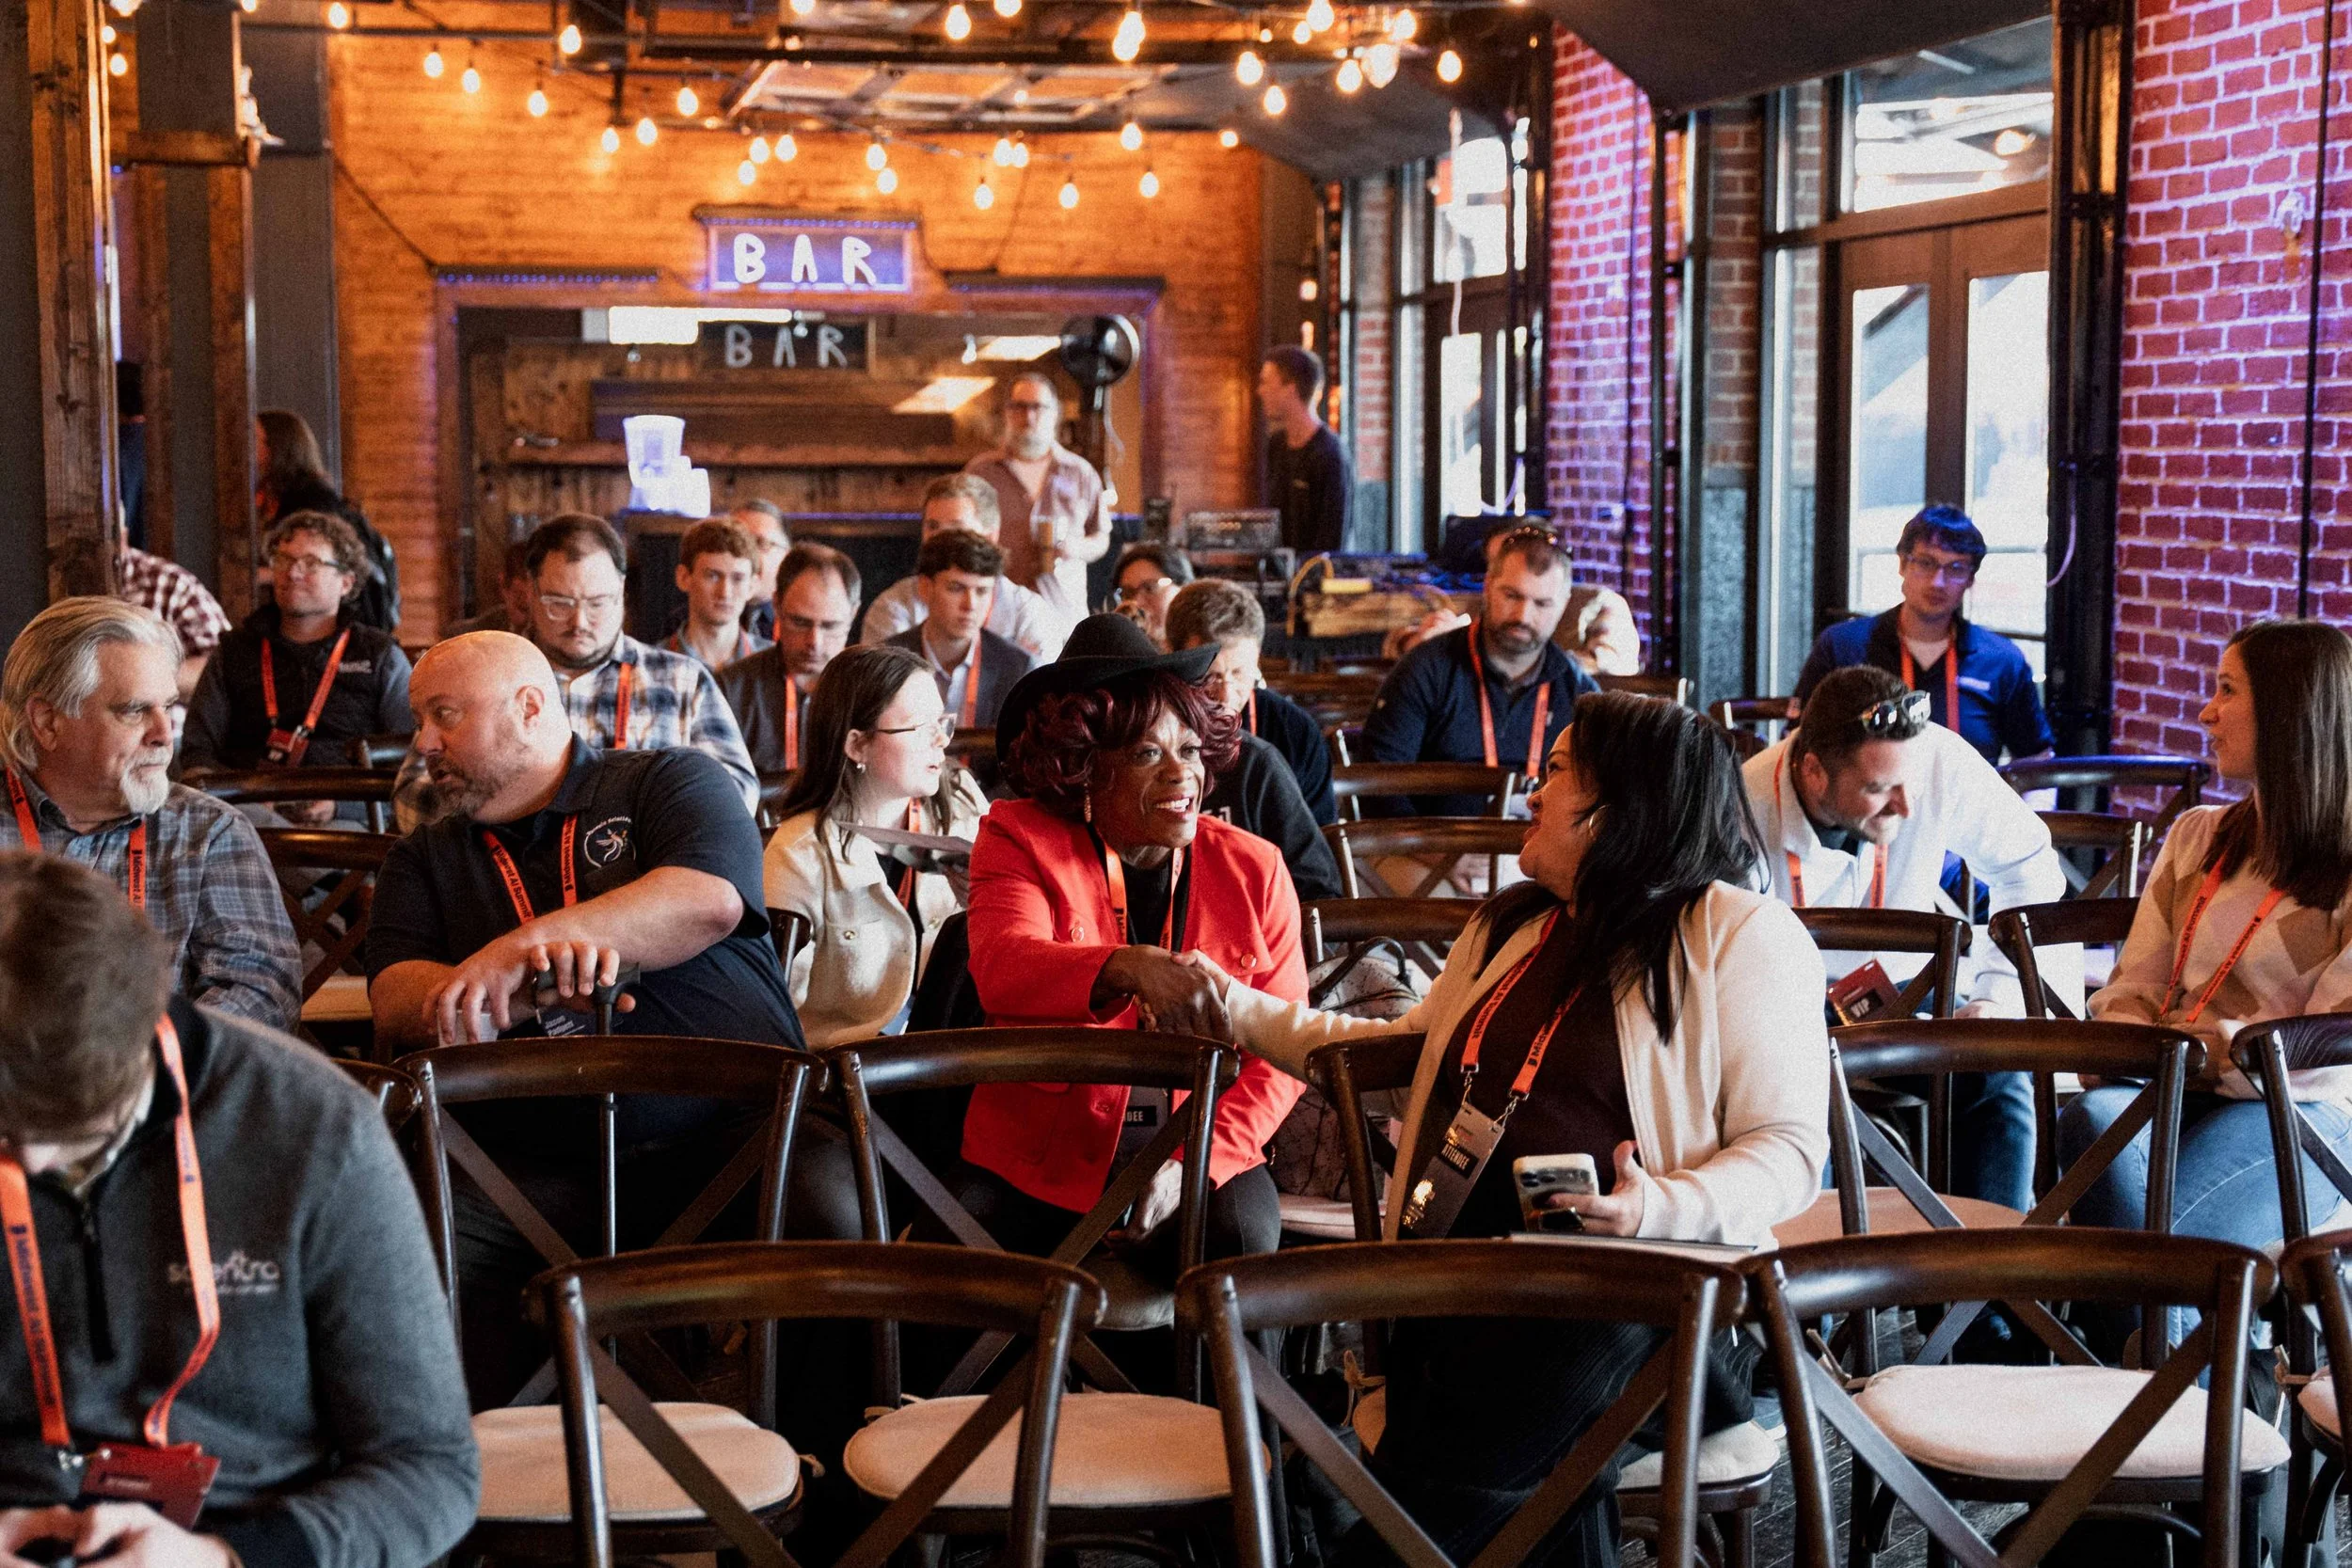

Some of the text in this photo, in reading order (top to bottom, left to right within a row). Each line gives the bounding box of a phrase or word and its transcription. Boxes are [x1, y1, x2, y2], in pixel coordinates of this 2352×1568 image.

[733, 232, 877, 286] BAR
[723, 325, 848, 369] BAR
[1850, 997, 1870, 1018] VIP
[1441, 1143, 1470, 1170] ATTENDEE
